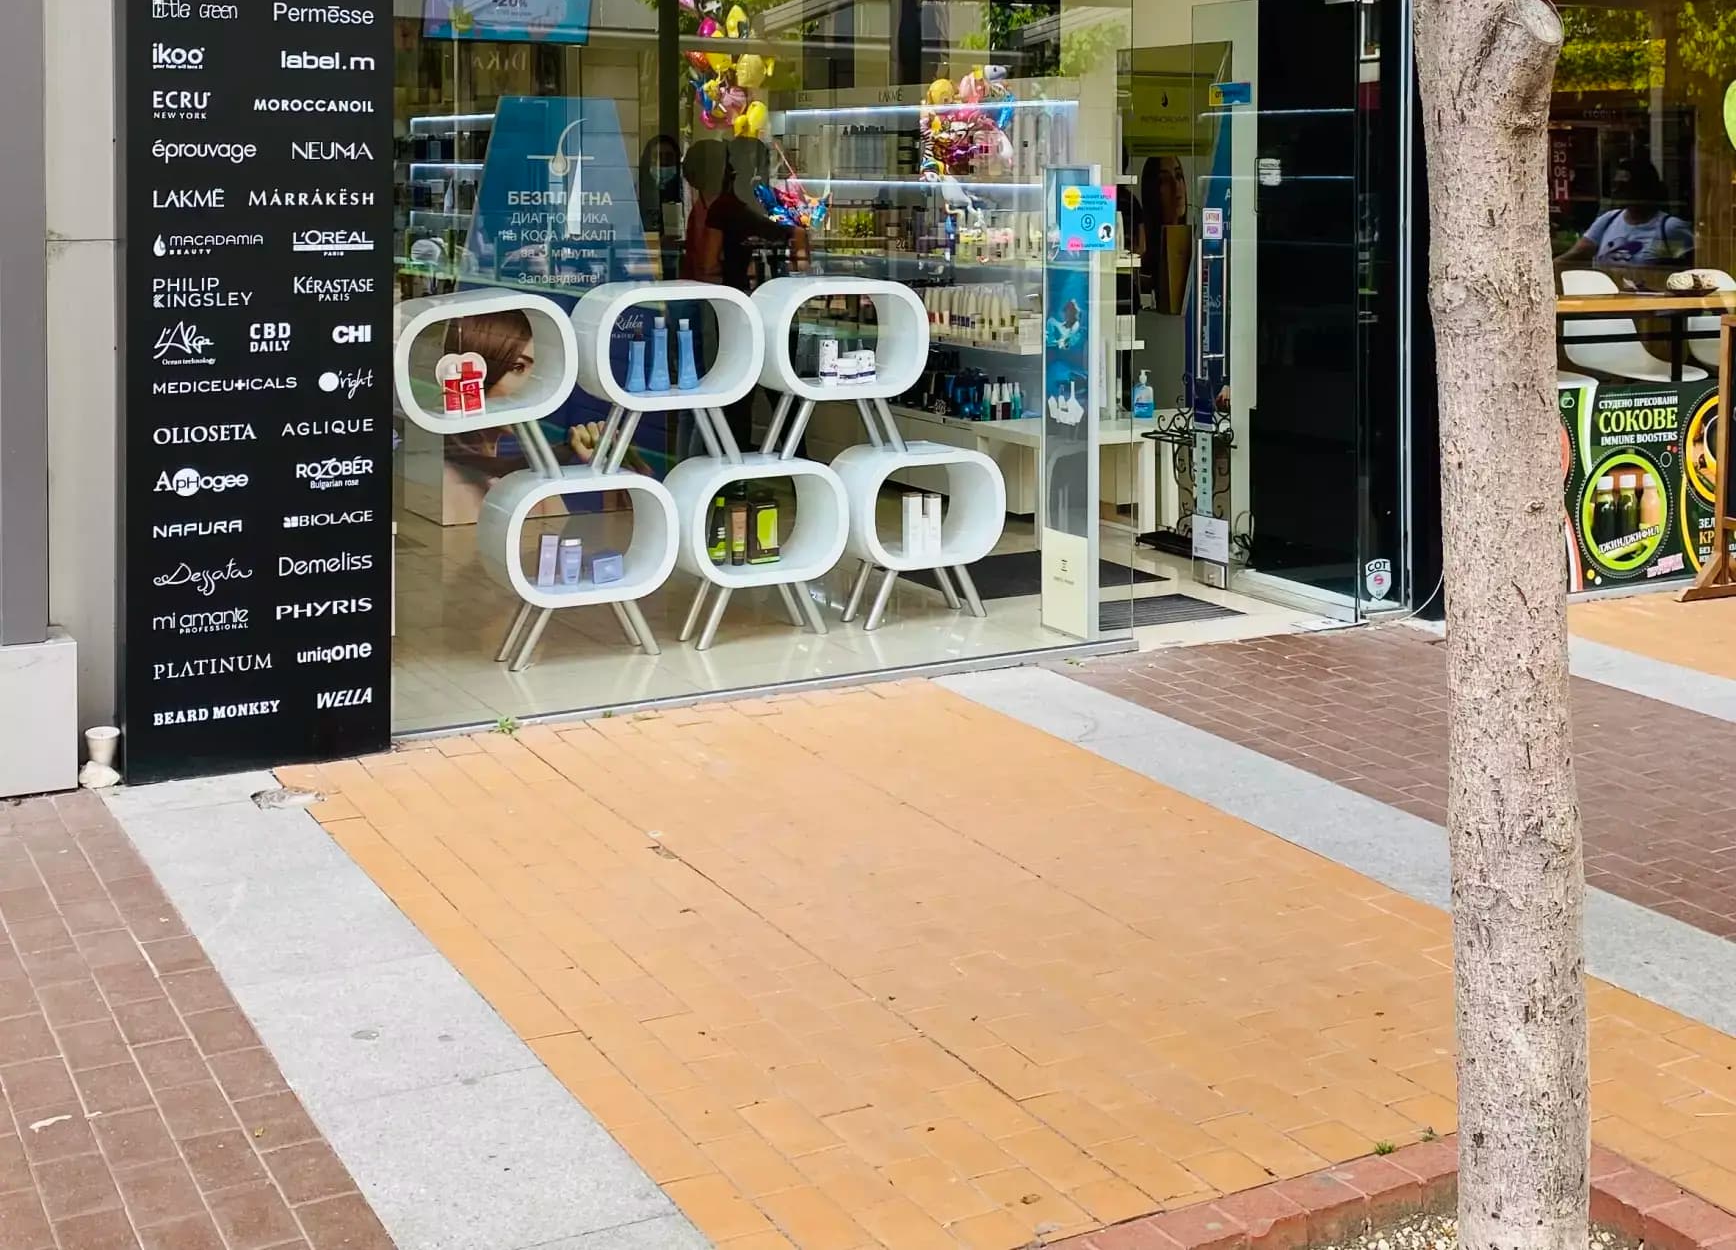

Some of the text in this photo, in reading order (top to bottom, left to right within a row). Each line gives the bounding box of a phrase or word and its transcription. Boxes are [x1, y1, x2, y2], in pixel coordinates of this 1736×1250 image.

[153, 43, 205, 64] ikoo
[281, 51, 374, 70] label.m
[153, 91, 210, 108] ECRU
[254, 99, 374, 112] MOROCCANOIL
[152, 139, 256, 163] éprouvage
[291, 142, 374, 160] NEUMA
[507, 191, 613, 206] БЕЗПЛТНА
[511, 212, 609, 225] ДИАГНОИКА
[170, 234, 263, 246] MACADAMIA
[293, 230, 374, 244] L'ORÉAL
[153, 278, 219, 292] PHILIP
[294, 276, 374, 293] KÉRASTASE
[518, 272, 600, 286] Заповядайте!
[153, 292, 252, 308] KINGSLEY
[319, 293, 350, 301] PARIS
[250, 323, 290, 339] CBD
[332, 325, 371, 343] CHI
[250, 340, 290, 352] DAILY
[282, 419, 374, 436] AGLIQUE
[1599, 407, 1678, 434] СОКОВЕ
[153, 423, 256, 444] OLIOSETA
[1601, 431, 1678, 446] IMMUNE BOOSTERS
[310, 480, 342, 490] Bulgarian
[300, 510, 373, 527] BIOLAGE
[153, 519, 243, 538] NAPURA
[279, 552, 373, 576] Demeliss
[276, 598, 372, 620] PHYRIS
[153, 607, 249, 630] mi amante
[180, 623, 249, 634] PROFESSIONAL
[153, 654, 272, 680] PLATINUM
[317, 687, 372, 710] WELLA
[153, 700, 280, 726] BEARD MONKEY
